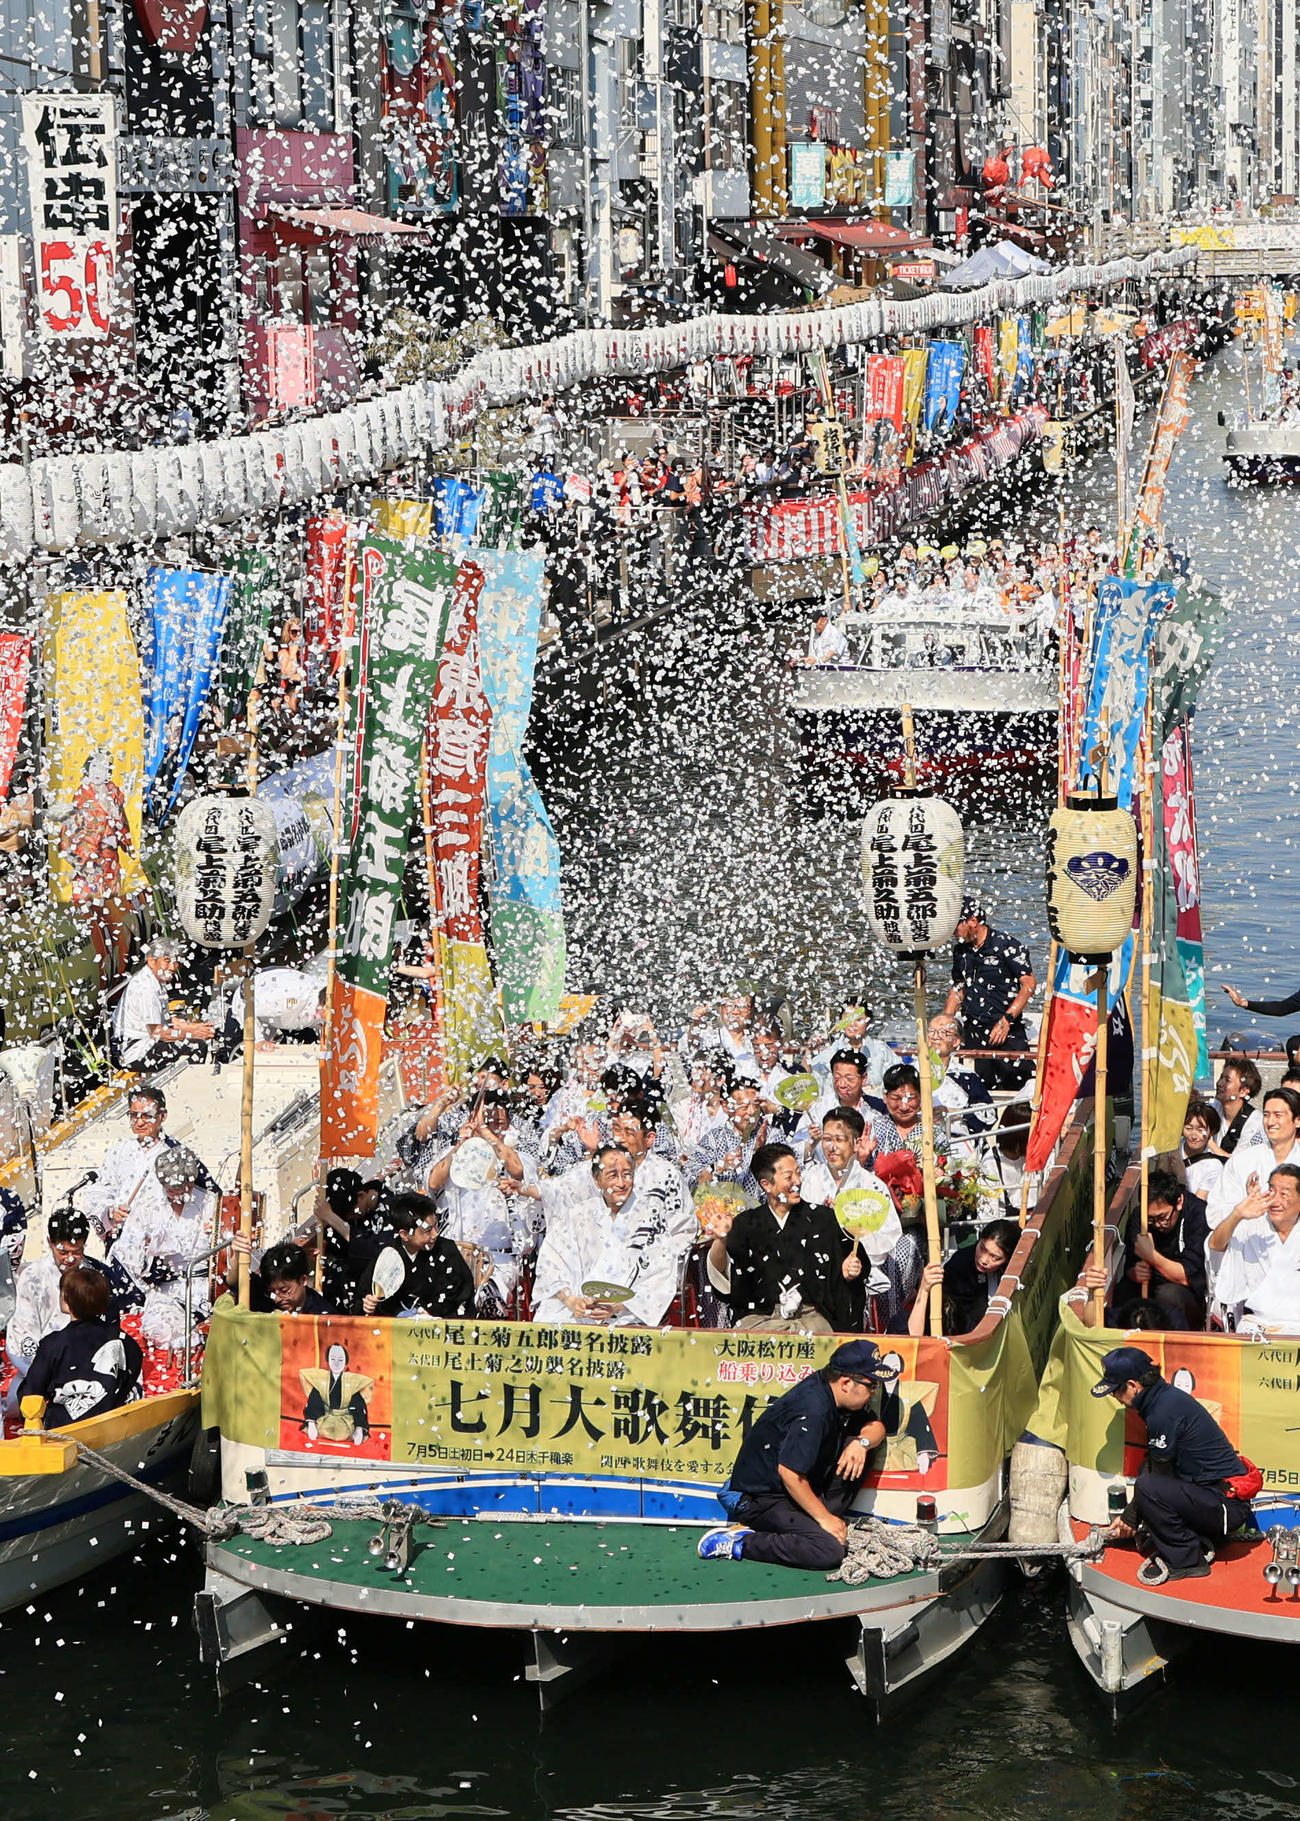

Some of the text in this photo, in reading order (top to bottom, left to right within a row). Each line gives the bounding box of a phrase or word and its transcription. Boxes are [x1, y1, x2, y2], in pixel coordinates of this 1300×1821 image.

[717, 1339, 816, 1360] 大阪松竹座
[717, 1361, 816, 1383] 船乗り込み
